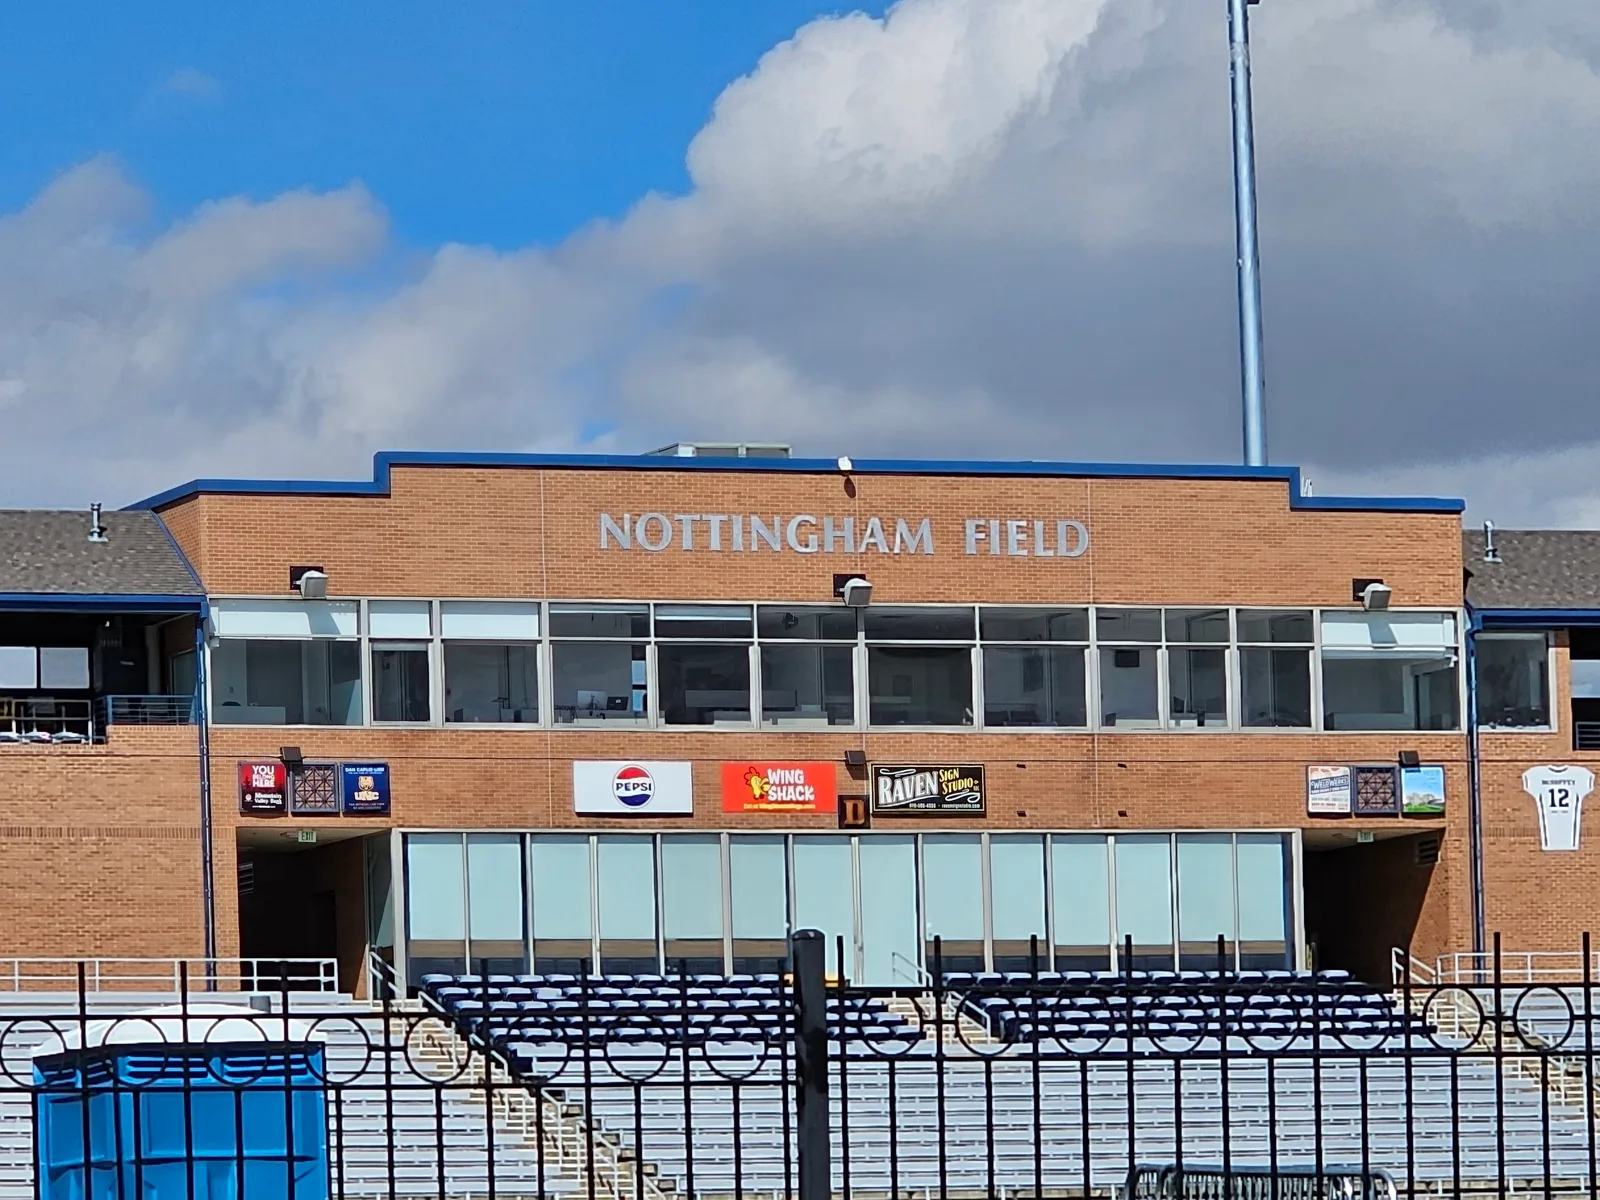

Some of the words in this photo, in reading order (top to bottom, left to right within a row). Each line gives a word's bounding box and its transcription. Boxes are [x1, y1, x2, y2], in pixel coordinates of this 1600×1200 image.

[600, 512, 935, 556] NOTTINGHAM
[966, 519, 1090, 558] FIELD
[252, 765, 275, 775] YOU
[766, 768, 804, 785] WING
[939, 768, 960, 783] SIGN
[252, 779, 275, 788] HERE
[616, 782, 652, 792] PEPSI
[878, 770, 939, 805] RAVEN
[942, 777, 974, 795] STUDIO
[354, 791, 380, 801] UNC
[767, 784, 815, 801] SHACK
[1548, 788, 1570, 808] 12
[844, 799, 866, 825] D
[301, 831, 314, 841] EXIT
